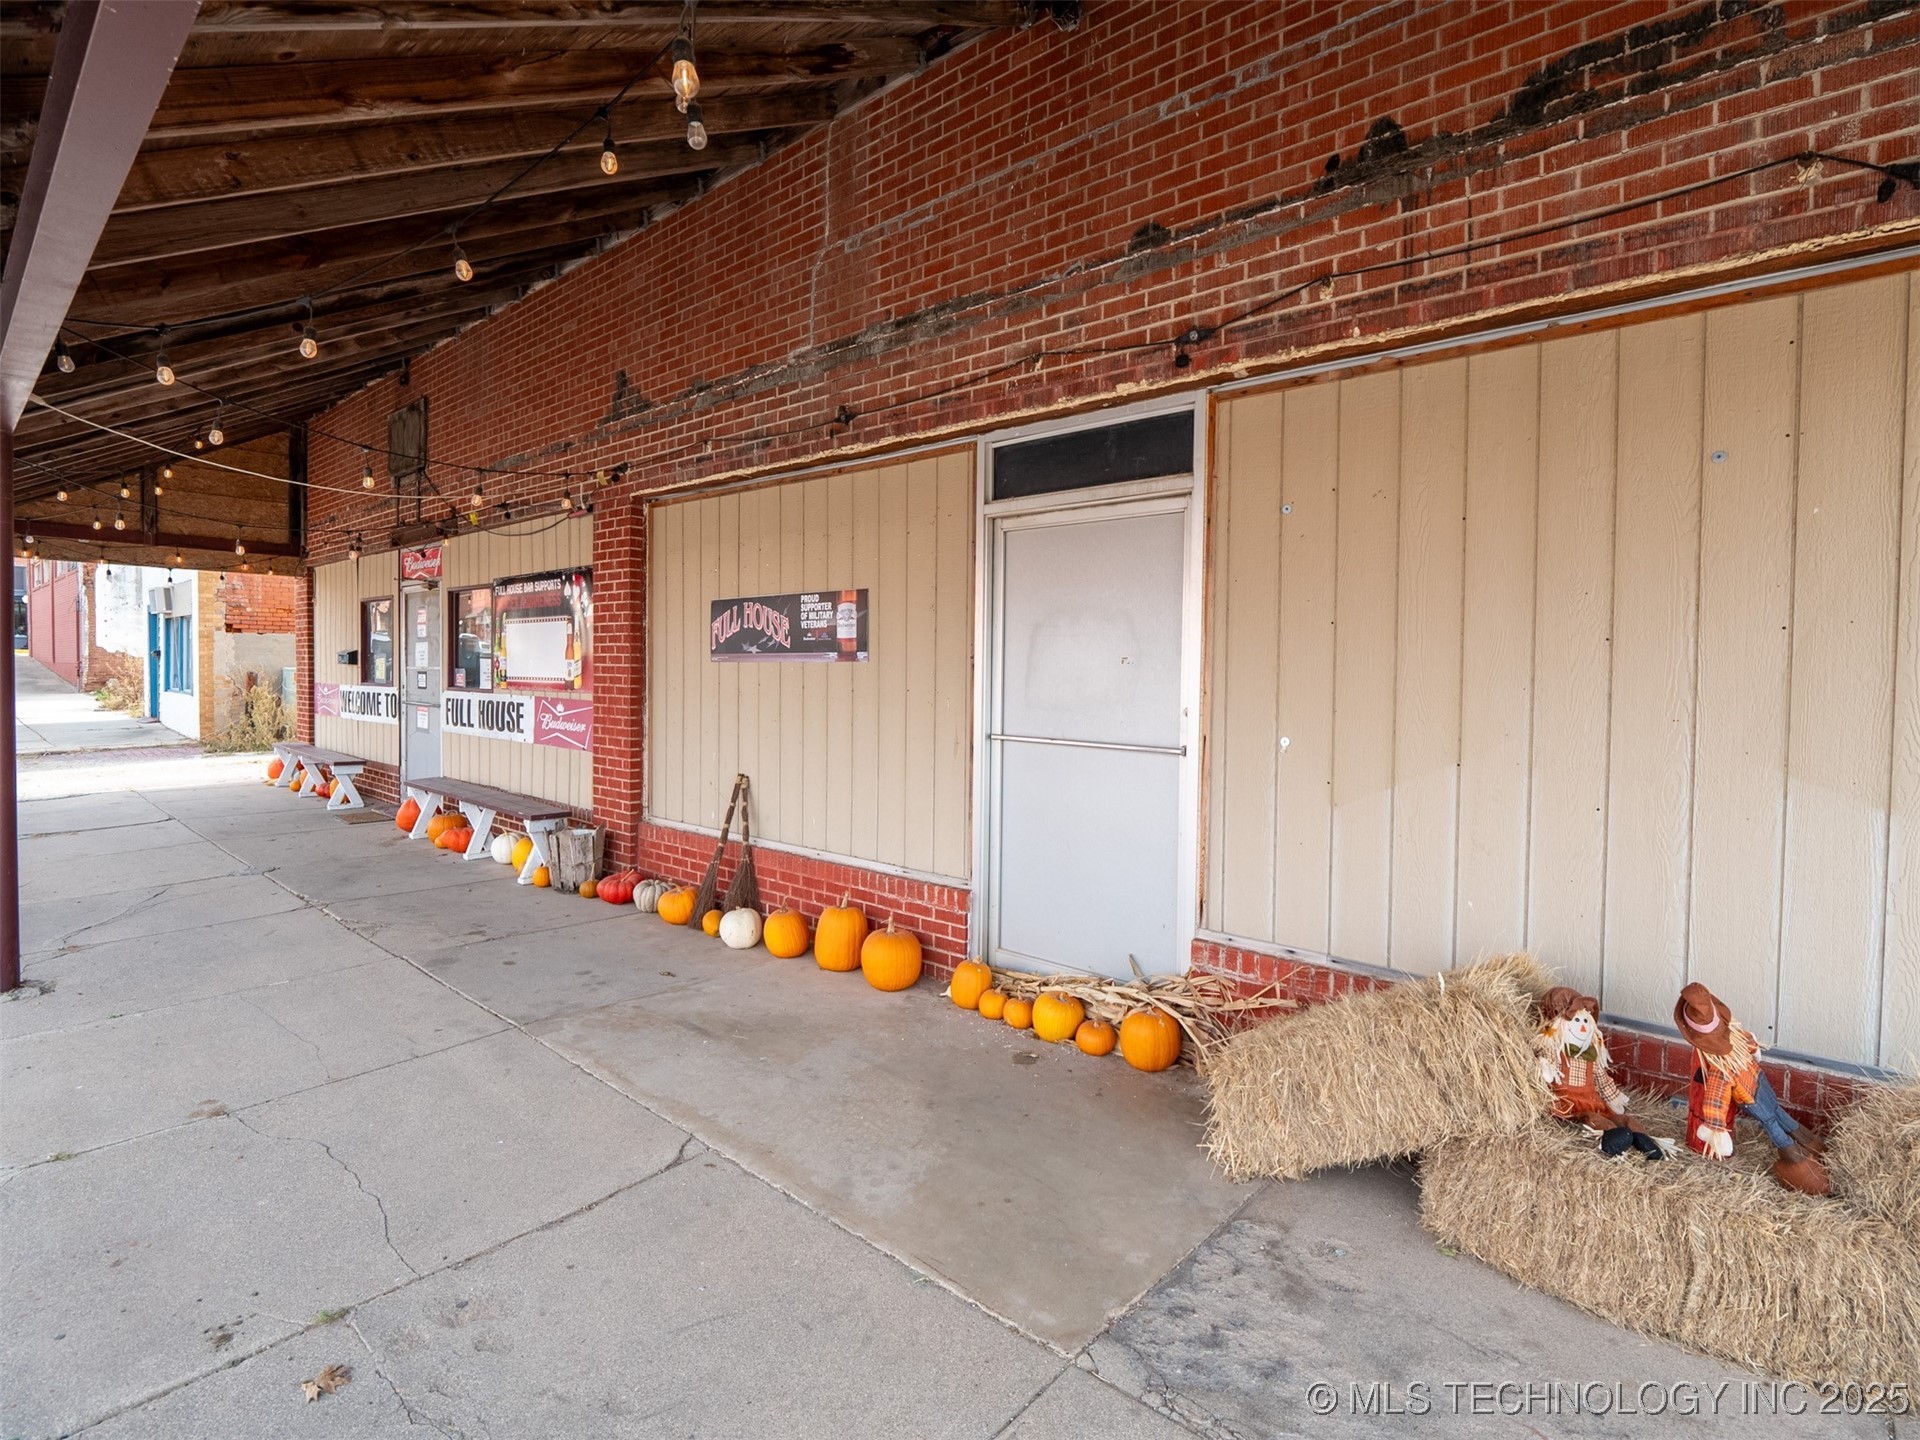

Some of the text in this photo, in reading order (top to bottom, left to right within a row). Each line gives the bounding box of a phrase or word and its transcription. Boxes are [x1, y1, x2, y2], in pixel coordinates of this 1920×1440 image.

[494, 579, 561, 596] FULL HOUSE BAR SUPPORTS
[800, 602, 832, 612] SUPPORTER
[801, 594, 819, 603] PROUD
[800, 612, 808, 621] OF
[808, 610, 833, 620] MILITARY
[711, 602, 791, 650] FULL HOUSE
[800, 620, 828, 629] VETERANS
[339, 689, 382, 717] WELCOME
[384, 692, 398, 718] TO
[445, 698, 474, 728] FULL
[479, 699, 524, 733] HOUSE
[540, 712, 587, 733] Budweiser
